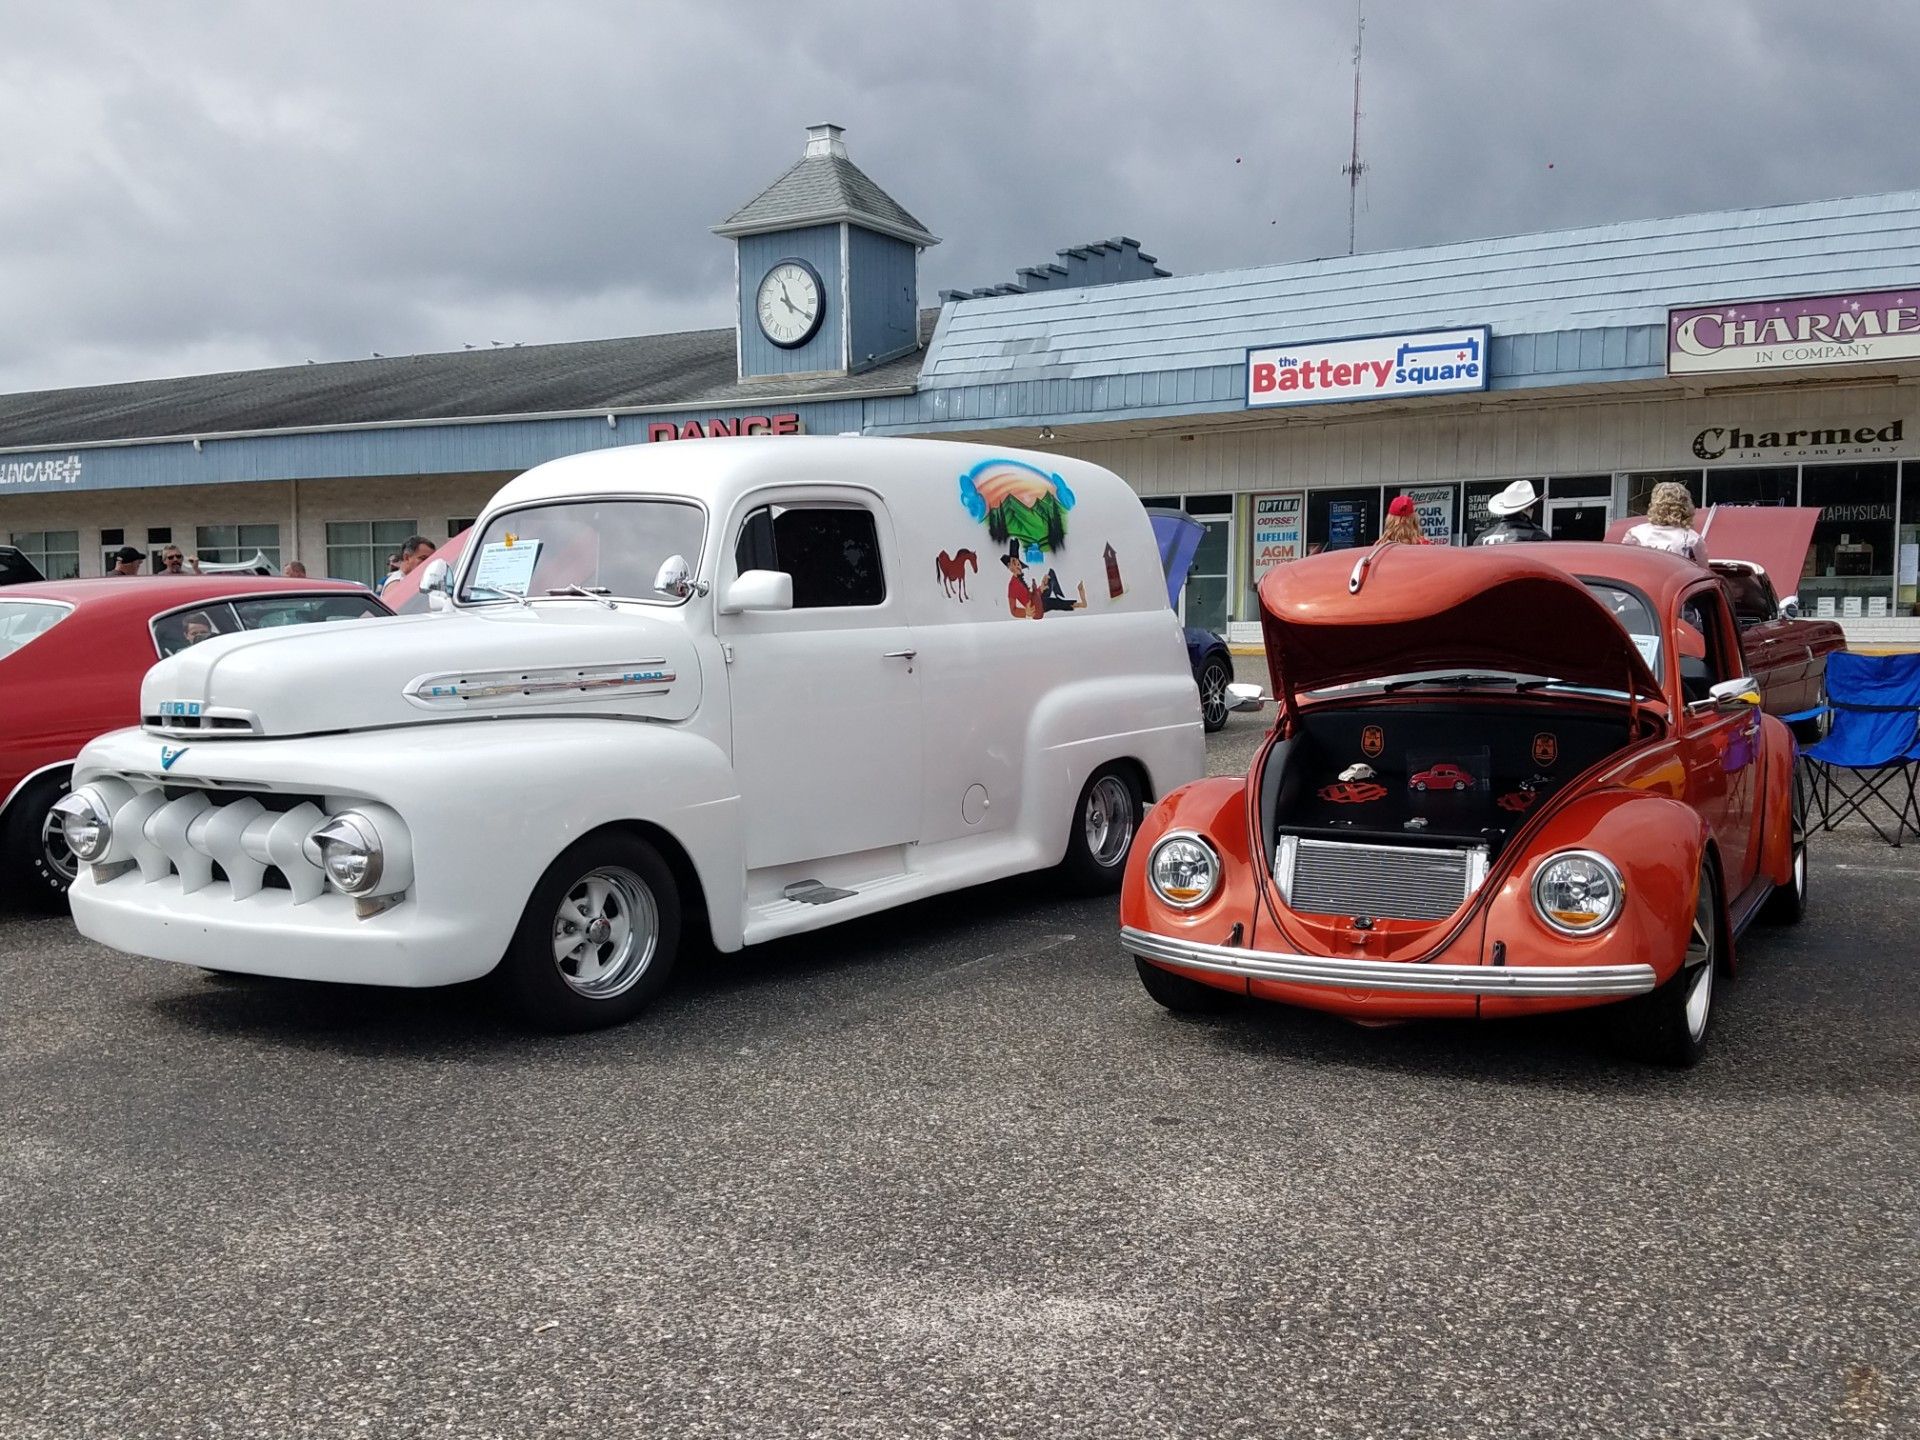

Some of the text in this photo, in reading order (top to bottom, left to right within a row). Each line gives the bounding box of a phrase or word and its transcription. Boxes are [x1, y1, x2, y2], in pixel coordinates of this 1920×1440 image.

[1755, 344, 1873, 363] IN COMPANY
[1278, 356, 1298, 368] the
[1253, 358, 1479, 393] Battery square
[648, 413, 799, 442] DANCE
[1692, 419, 1904, 460] Charmed
[1738, 445, 1899, 459] in company
[1259, 499, 1300, 512] OPTIMA
[1821, 504, 1893, 520] TAPHYSICAL
[1257, 516, 1299, 526] ODYSSEY
[1257, 531, 1299, 542] LIFELINE
[1261, 545, 1294, 558] AGM
[160, 702, 200, 715] FORD
